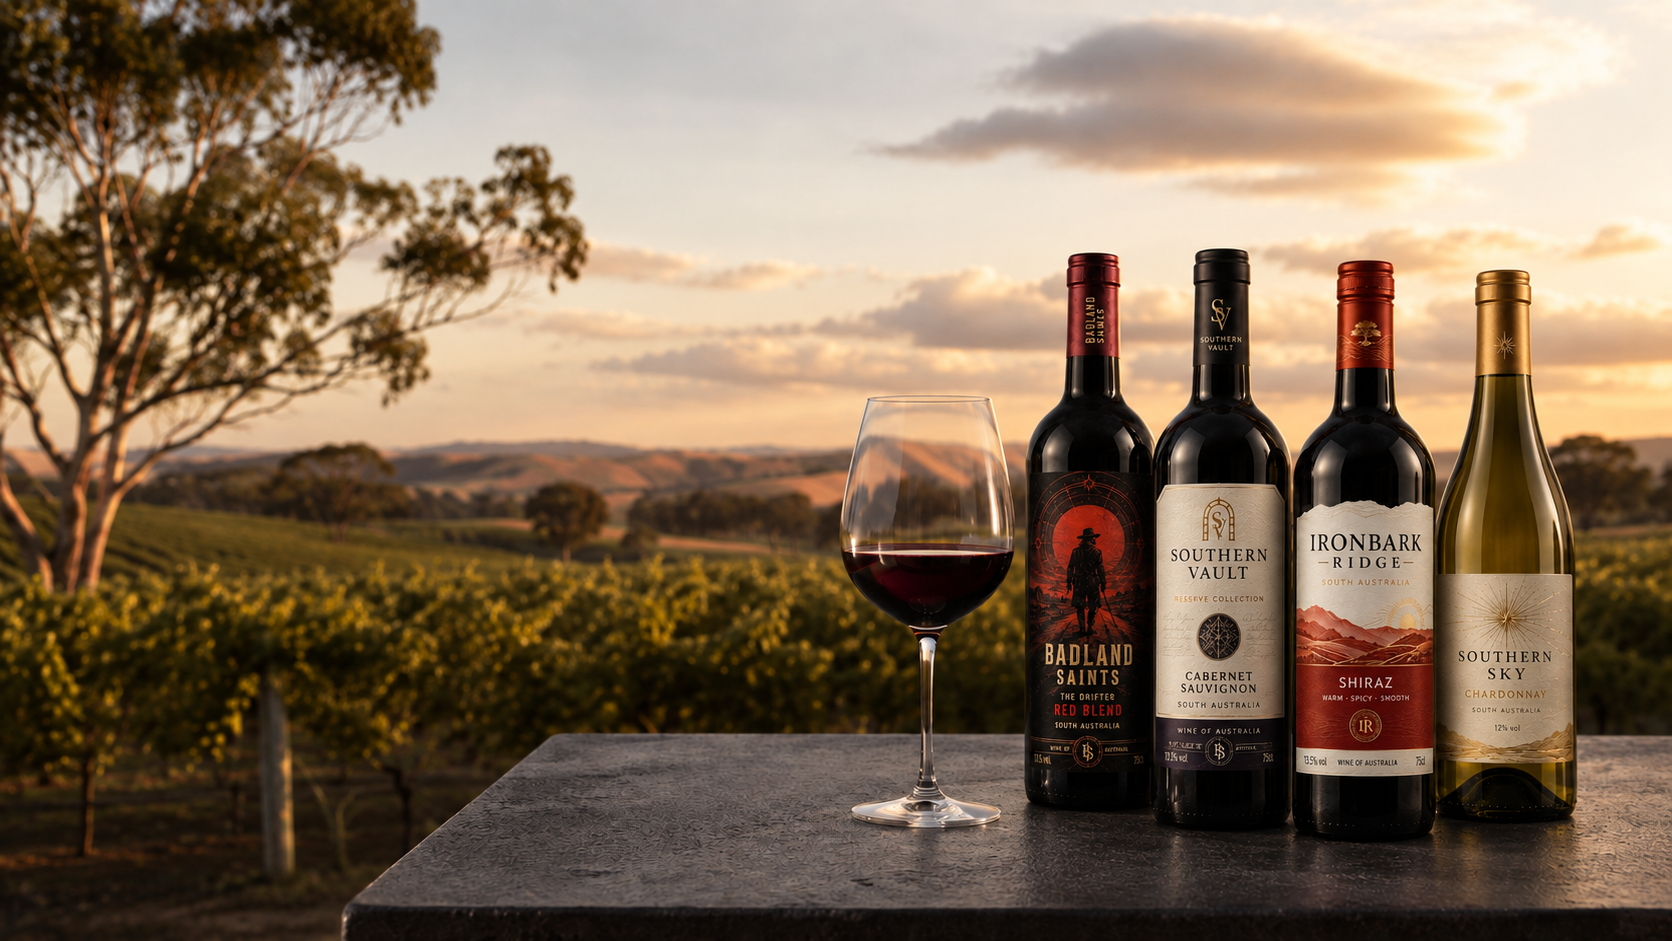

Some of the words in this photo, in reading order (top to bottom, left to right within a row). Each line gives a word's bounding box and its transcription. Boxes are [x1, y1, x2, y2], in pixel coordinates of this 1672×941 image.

[1310, 533, 1421, 552] IRONBARK
[1171, 548, 1267, 562] SOUTHERN
[1333, 556, 1401, 569] RIDGE
[1188, 566, 1249, 580] VAULT
[1321, 578, 1353, 586] SOUTH
[1358, 578, 1410, 586] AUSTRALIA
[1045, 643, 1133, 666] BADLAND
[1458, 650, 1552, 663] SOUTHERN
[1056, 669, 1120, 686] SAINTS
[1185, 671, 1253, 681] CABERNET
[1487, 667, 1526, 680] SKY
[1181, 683, 1257, 694] SAUVIGNON
[1339, 677, 1393, 689] SHIRAZ
[1060, 693, 1076, 701] THE
[1465, 689, 1547, 699] CHARDONNAY
[1054, 704, 1077, 716] RED
[1082, 704, 1122, 717] BLEND
[1177, 701, 1207, 709] SOUTH
[1211, 701, 1260, 709] AUSTRALIA
[1080, 722, 1120, 730] AUSTRALIA
[1177, 727, 1198, 735] WINE
[1201, 727, 1211, 735] OF
[1215, 727, 1261, 735] AUSTRALIA
